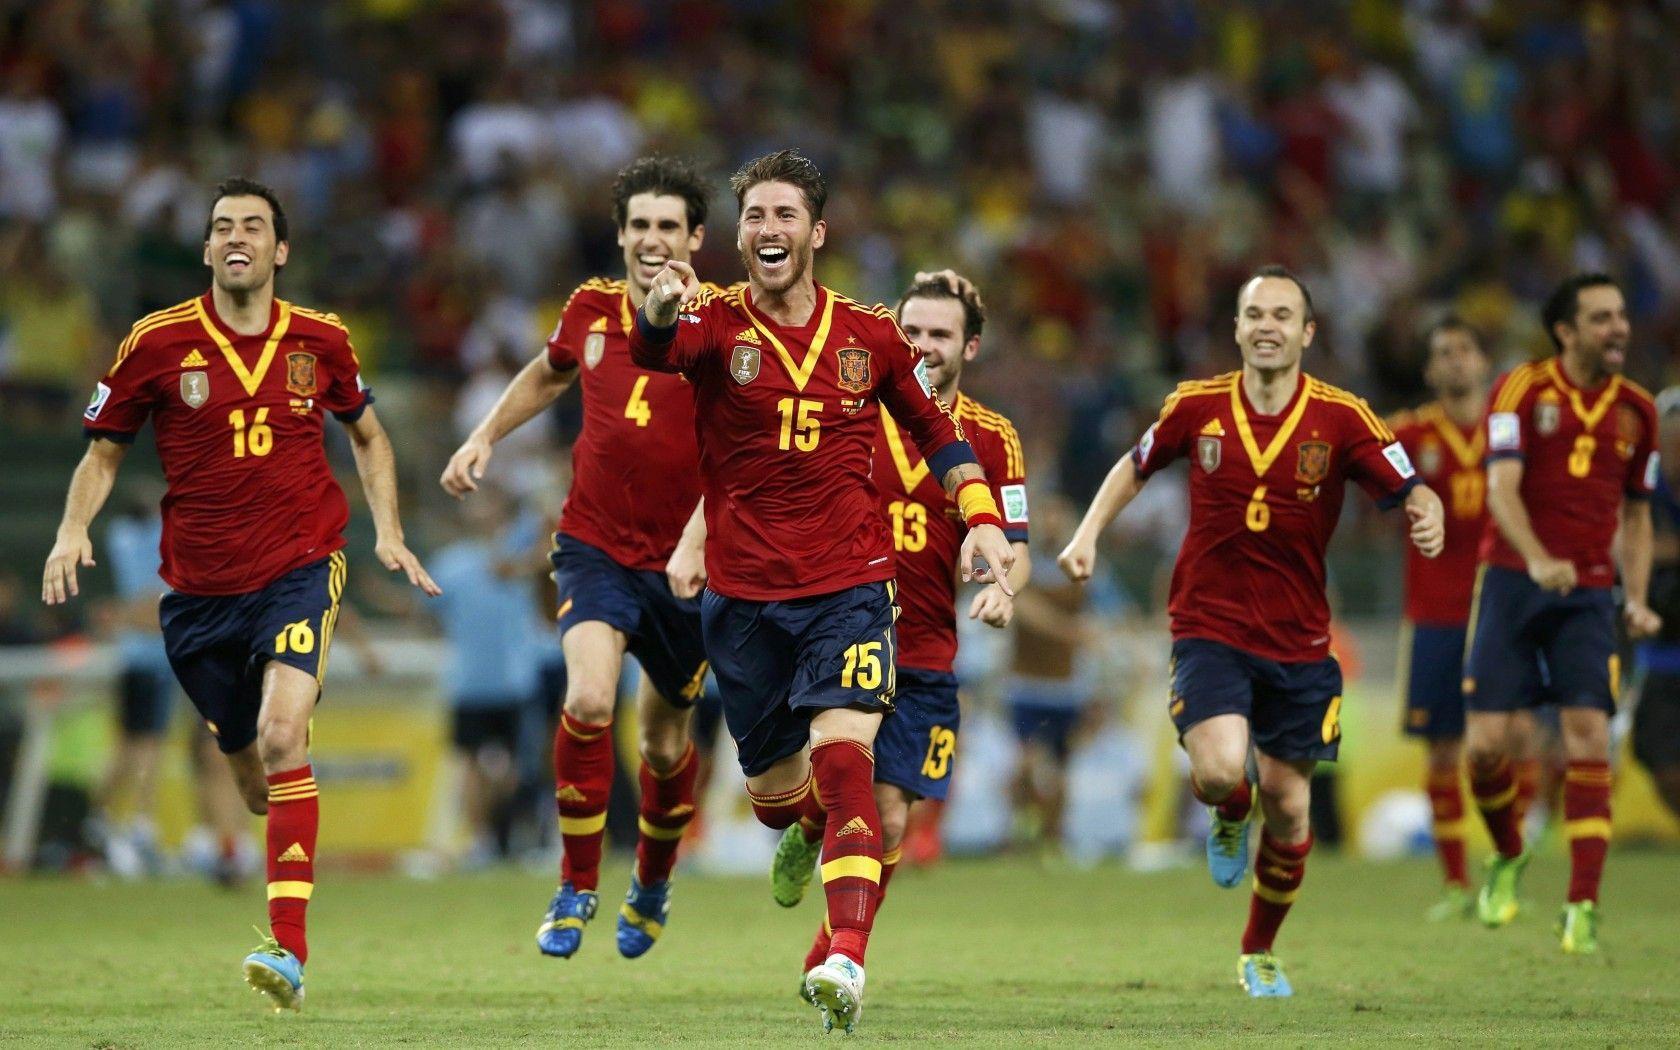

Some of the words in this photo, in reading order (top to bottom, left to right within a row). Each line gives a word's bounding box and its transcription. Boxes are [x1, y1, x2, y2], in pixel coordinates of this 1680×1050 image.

[625, 375, 651, 427] 4
[777, 397, 824, 452] 15
[229, 407, 273, 458] 16
[1568, 434, 1596, 478] 8
[888, 500, 927, 552] 13
[1246, 485, 1270, 532] 6
[841, 641, 882, 690] 15
[920, 725, 956, 779] 13
